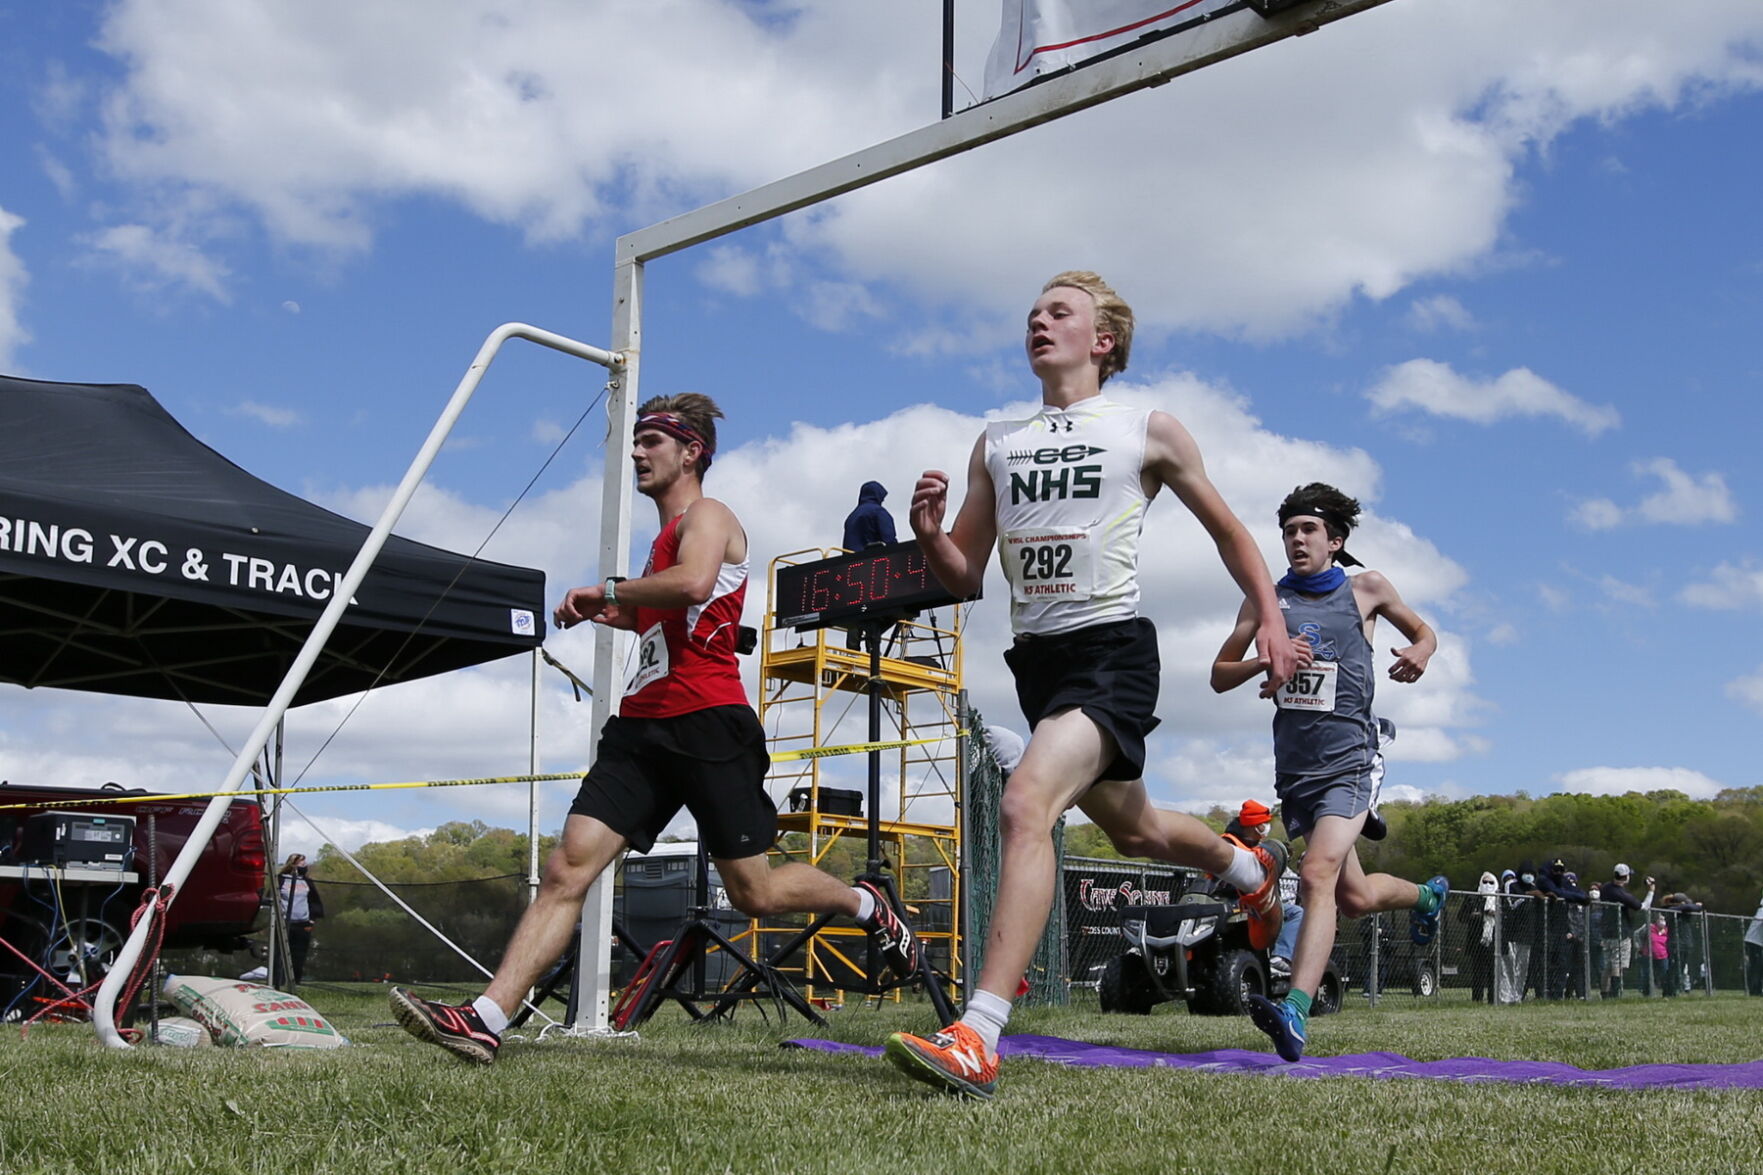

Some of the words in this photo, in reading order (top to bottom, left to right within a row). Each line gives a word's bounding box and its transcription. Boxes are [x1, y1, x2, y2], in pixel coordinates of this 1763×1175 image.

[1010, 464, 1102, 506] NHS
[1025, 533, 1087, 544] CHAMPIONSHIPS
[107, 533, 169, 575] XC
[181, 548, 210, 582] &
[1020, 543, 1074, 581] 292
[1035, 583, 1077, 595] ATHLETIC
[1286, 672, 1326, 695] 357
[1294, 697, 1326, 706] ATHLETIC
